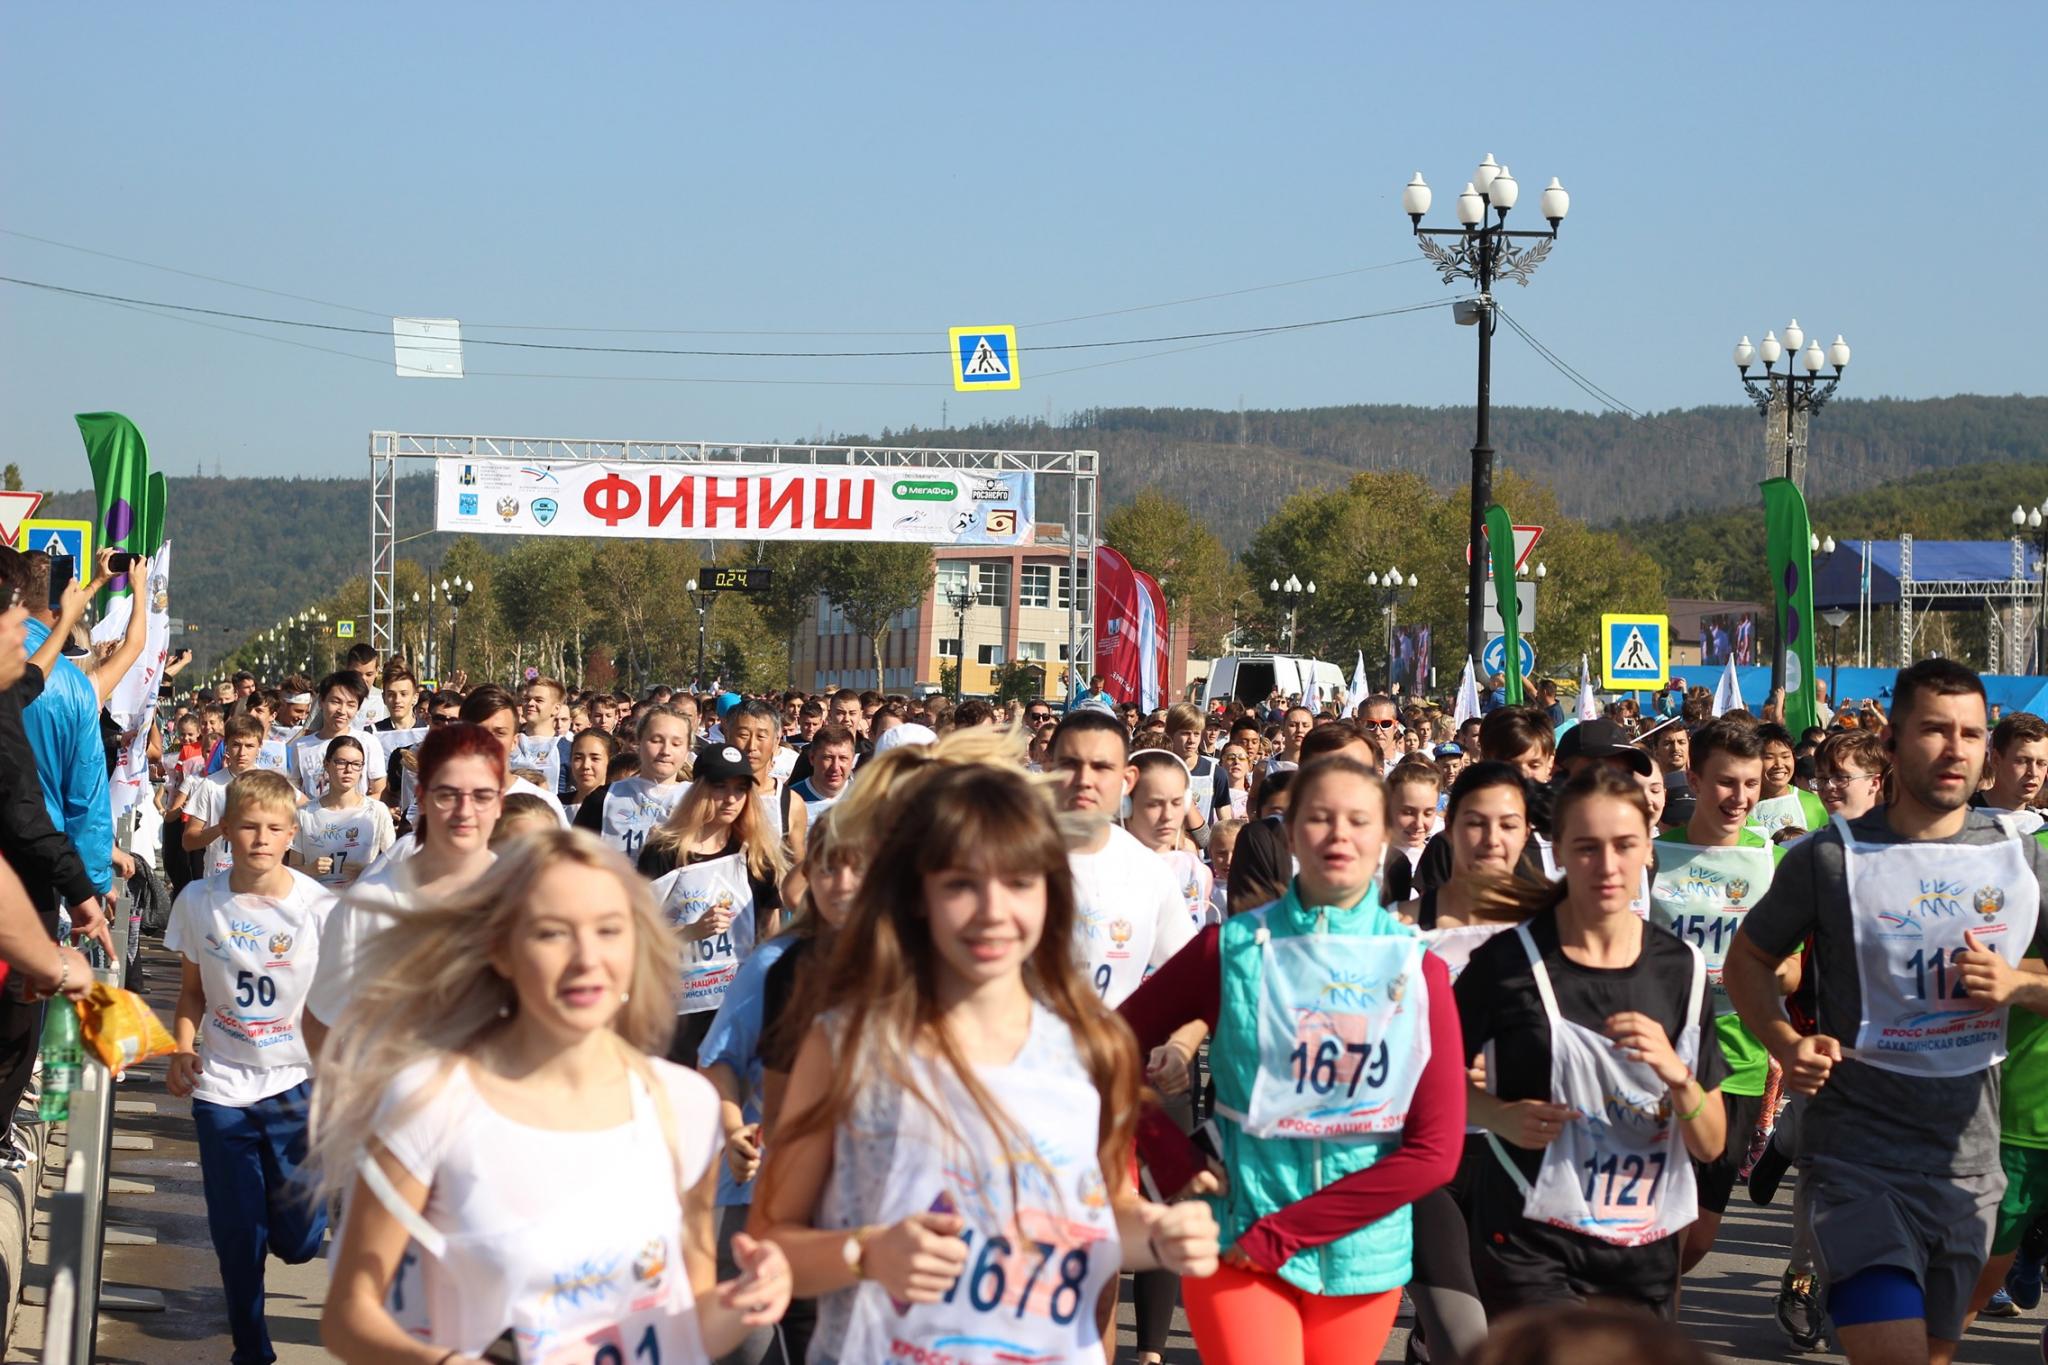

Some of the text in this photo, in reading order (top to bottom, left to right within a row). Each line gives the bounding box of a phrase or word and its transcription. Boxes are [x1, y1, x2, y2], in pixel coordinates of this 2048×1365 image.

[583, 473, 875, 530] ФИНИШ
[973, 490, 1008, 500] РОСЭНЕРГО
[329, 851, 348, 875] 17
[1671, 914, 1738, 954] 1511
[236, 970, 276, 1008] 50
[691, 977, 719, 990] НАЦИИ
[1877, 1031, 1999, 1052] САХАЛИНСКАЯ ОБЛАСТЬ
[1882, 1027, 1922, 1038] КРОСС
[1290, 1039, 1389, 1099] 1679
[1277, 1117, 1321, 1135] КРОСС
[1584, 1151, 1668, 1207] 1127
